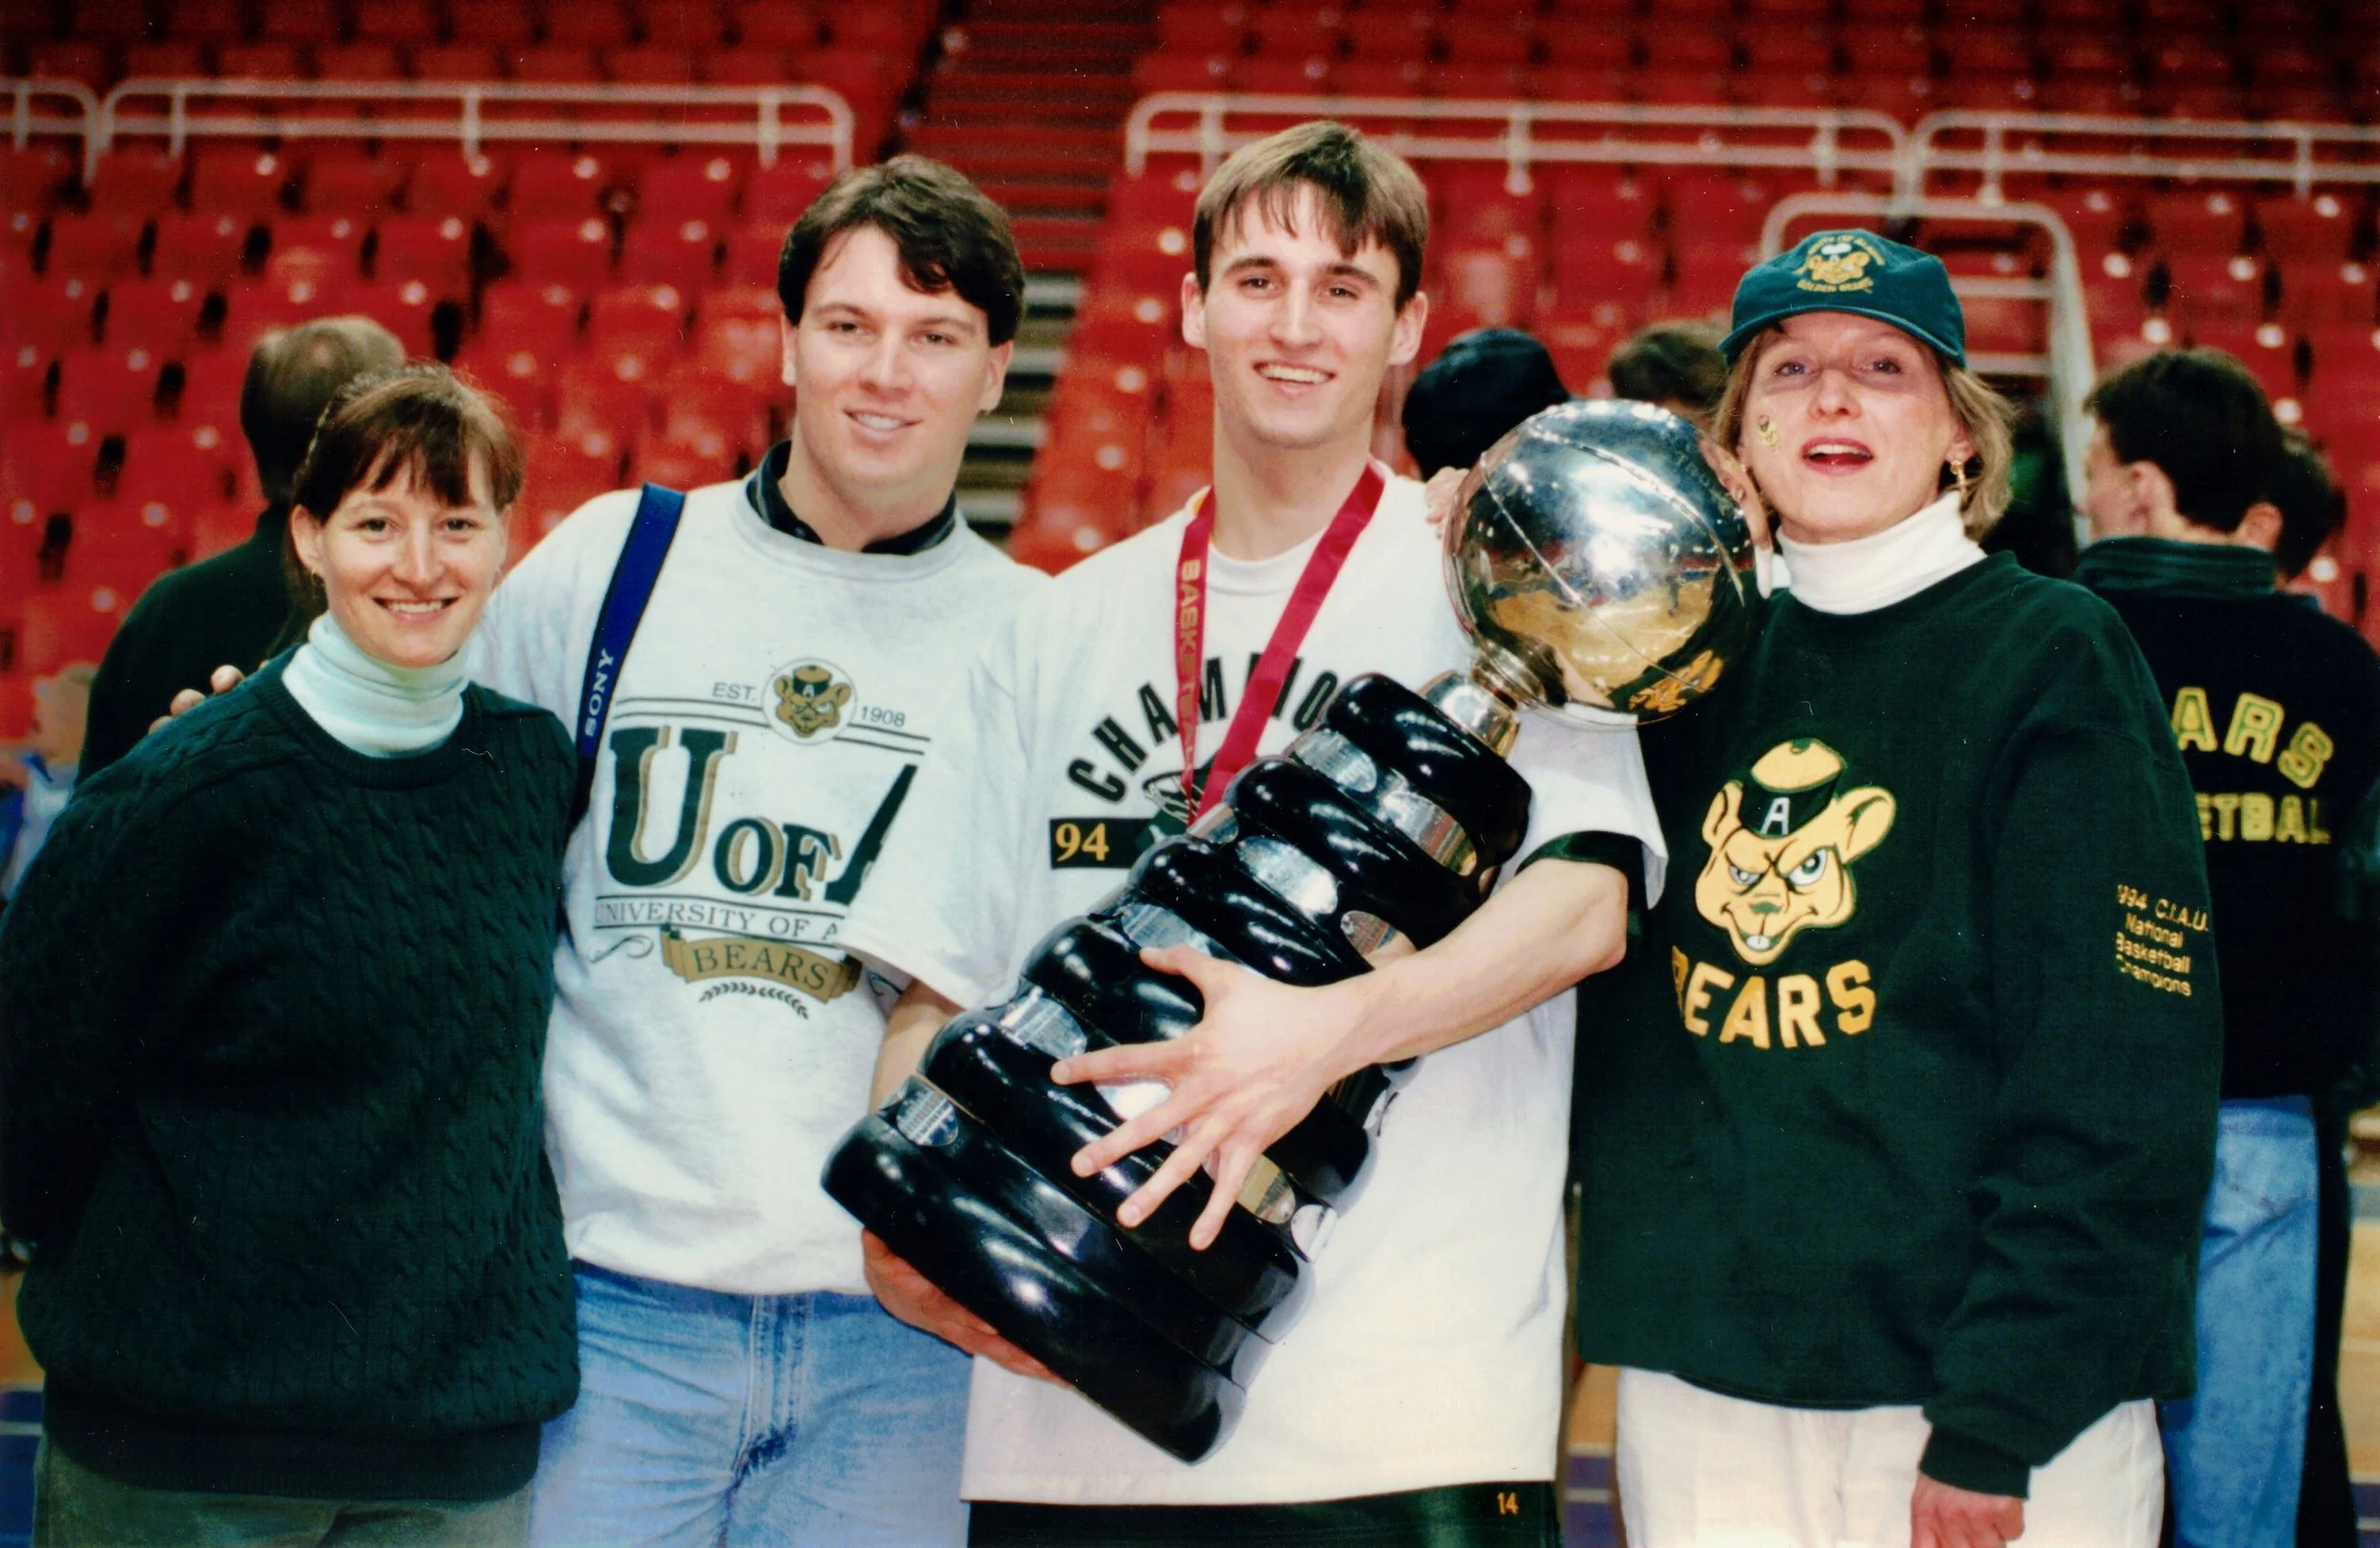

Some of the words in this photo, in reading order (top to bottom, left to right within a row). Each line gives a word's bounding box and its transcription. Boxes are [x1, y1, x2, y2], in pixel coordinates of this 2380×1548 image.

[585, 647, 614, 737] SONY
[712, 681, 756, 703] EST.
[861, 705, 906, 727] 1908
[1067, 651, 1337, 804] CHAMIO
[2172, 686, 2334, 789] ARS
[1761, 797, 1791, 836] A
[1055, 822, 1110, 863] 94
[594, 902, 755, 931] UNIVERSITY
[768, 916, 809, 938] OF
[2125, 912, 2184, 949] National
[693, 943, 829, 991] BEARS
[2115, 931, 2191, 974] Basketball
[1497, 1492, 1519, 1516] 14
